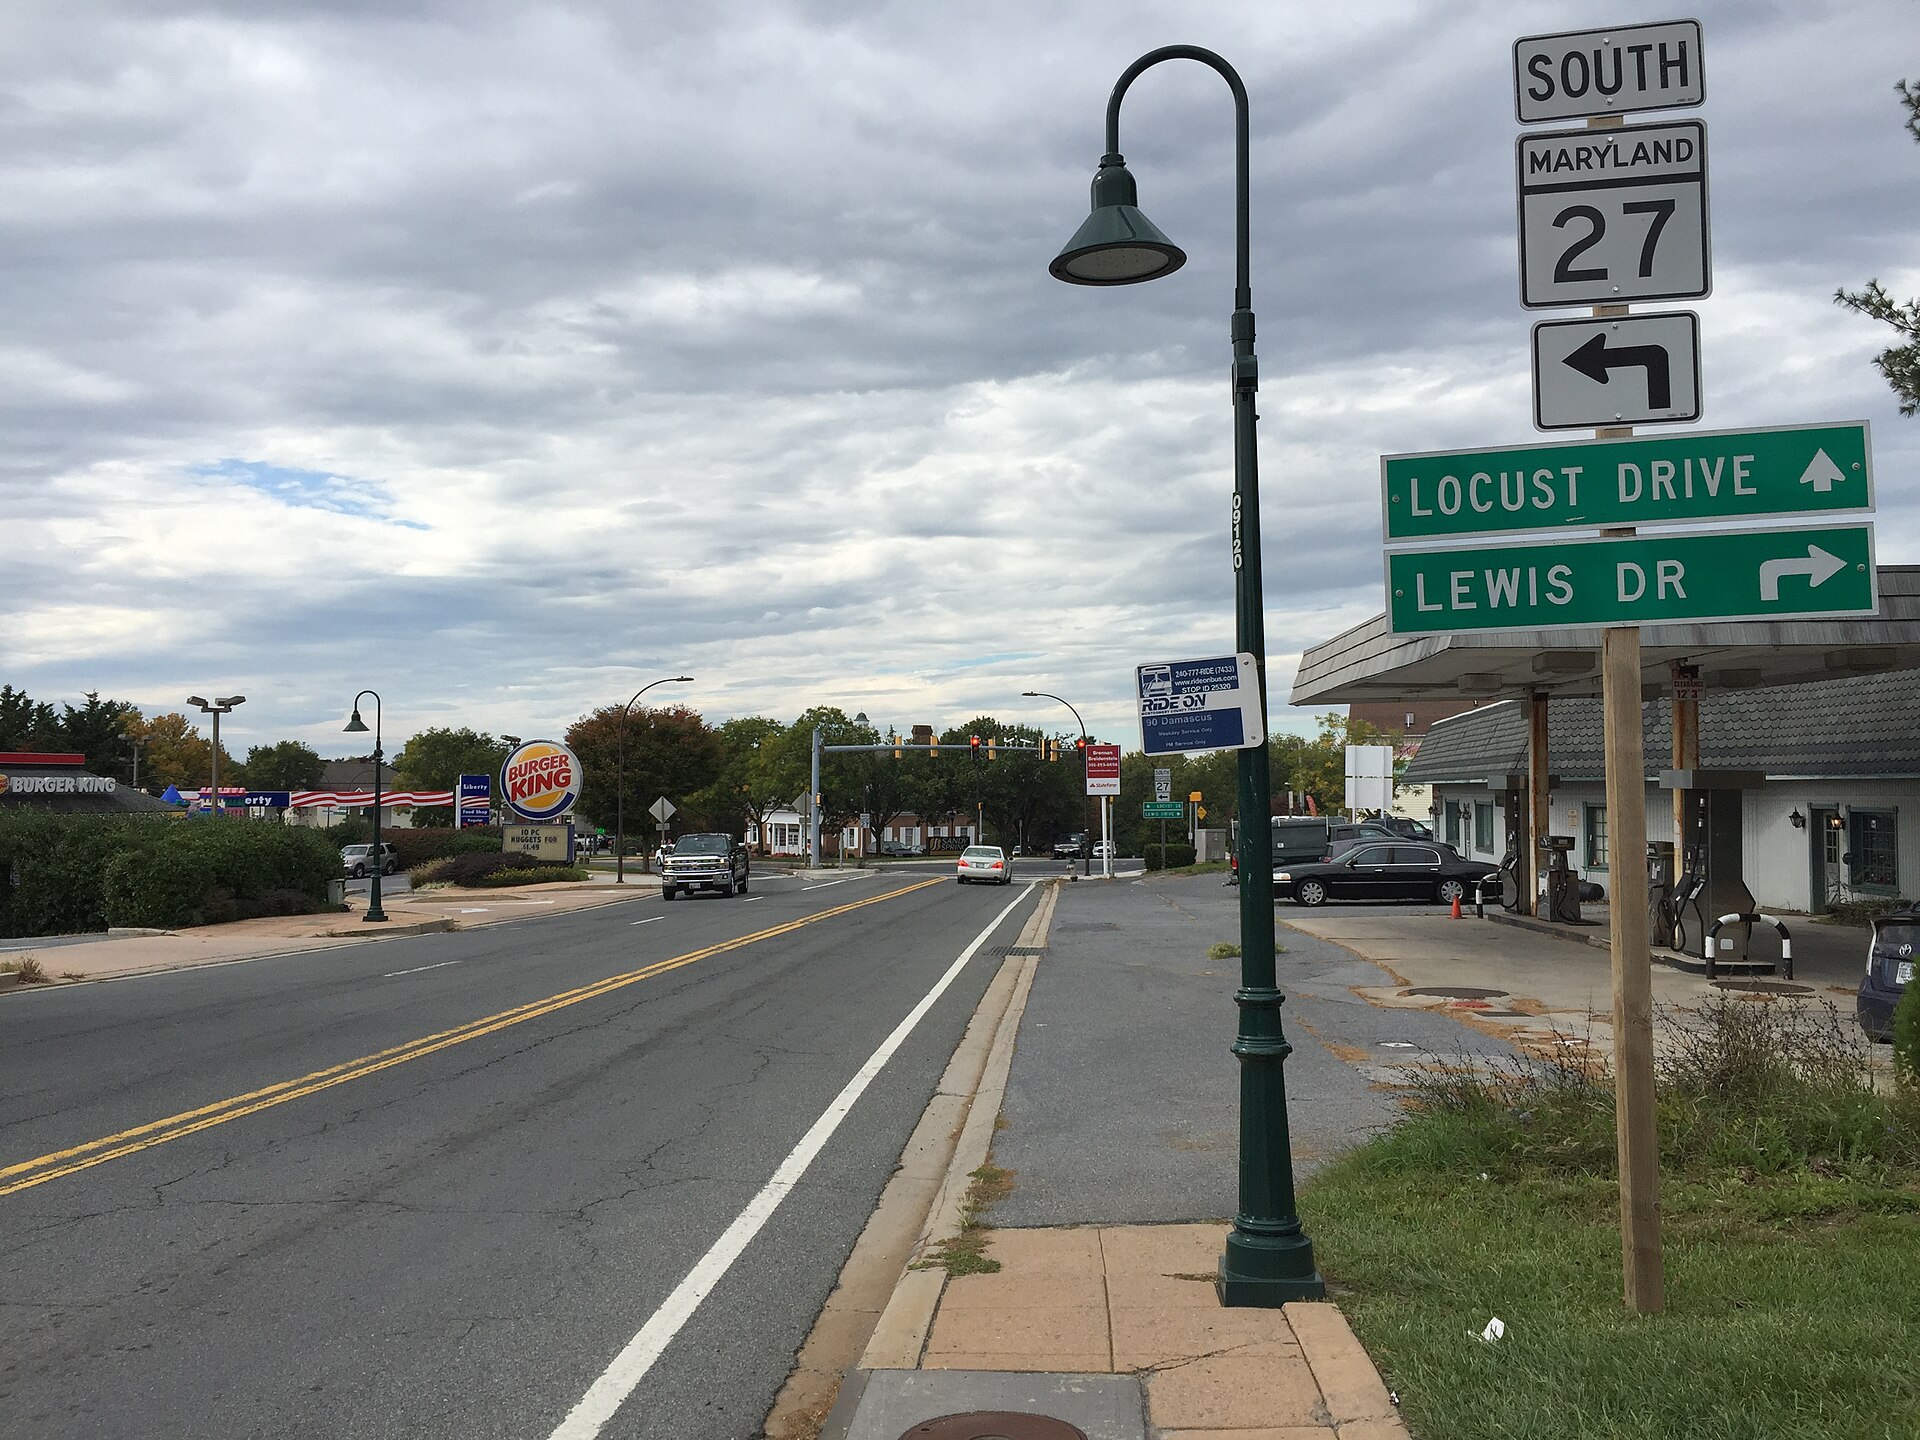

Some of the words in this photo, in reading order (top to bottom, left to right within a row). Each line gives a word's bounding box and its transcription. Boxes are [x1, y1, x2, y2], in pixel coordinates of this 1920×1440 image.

[1526, 40, 1690, 103] SOUTH
[1529, 138, 1695, 175] MARYLAND
[1552, 199, 1676, 284] 27
[1410, 466, 1584, 518] LOCUST
[1618, 454, 1758, 503] DRIVE
[1233, 494, 1243, 569] 09120
[1415, 564, 1574, 613] LEWIS
[1617, 559, 1688, 603] DR
[1174, 675, 1238, 687] www.rideonbus.com
[1175, 667, 1215, 678] 240-777-RIDE
[1215, 665, 1235, 675] (7433)
[1181, 686, 1201, 694] STOP
[1211, 683, 1231, 691] 25320
[1183, 693, 1206, 708] ON
[1146, 718, 1158, 727] 90
[1161, 714, 1213, 726] Damascus
[509, 754, 569, 782] BURGER
[10, 777, 75, 793] BURGER
[77, 777, 117, 793] KING
[511, 768, 571, 802] KING
[1156, 782, 1170, 791] 27
[244, 795, 273, 806] erty
